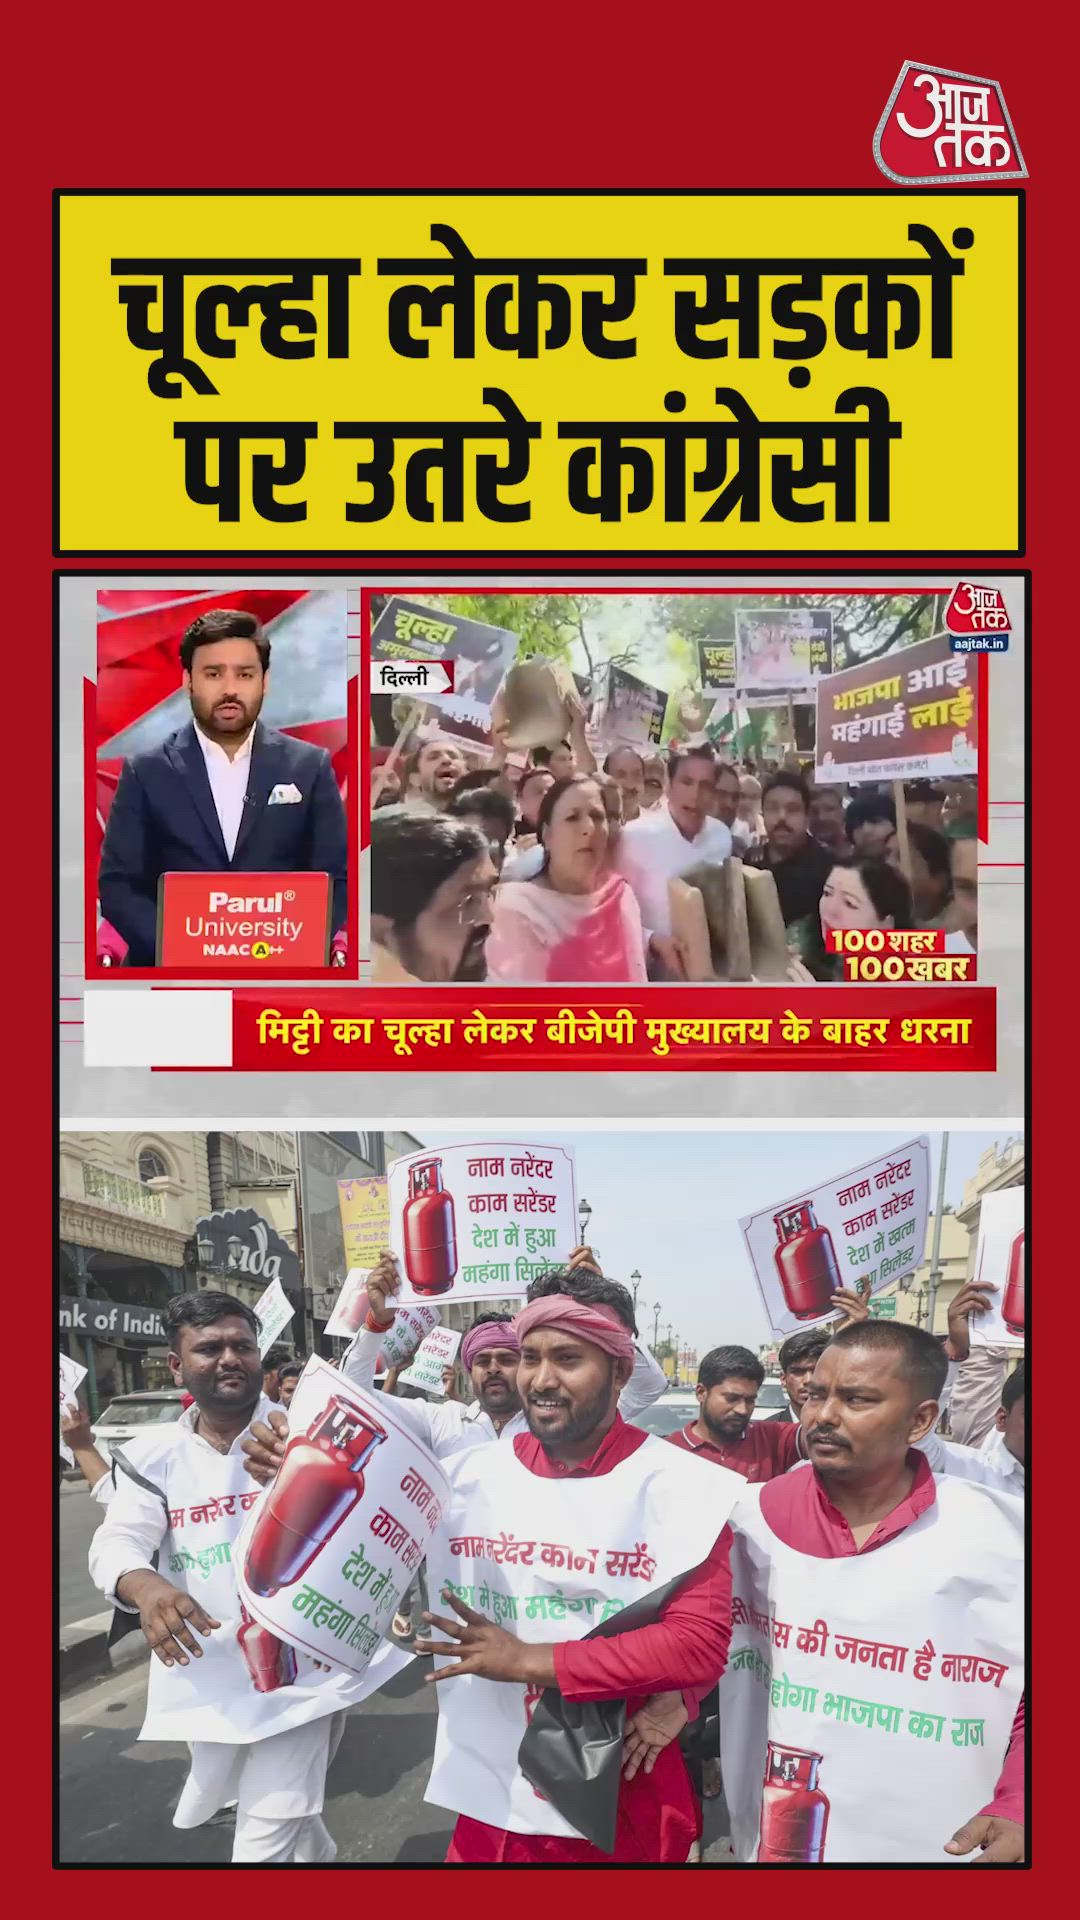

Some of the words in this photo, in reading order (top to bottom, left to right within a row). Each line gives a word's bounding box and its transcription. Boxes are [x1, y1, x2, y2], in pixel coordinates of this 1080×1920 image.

[833, 676, 901, 711] भाजपा
[907, 652, 969, 693] आई
[831, 702, 906, 744] महंगाई
[909, 686, 975, 729] लाई
[185, 917, 303, 941] University
[203, 944, 250, 956] NAAC
[467, 1158, 504, 1178] नाम
[510, 1151, 553, 1179] नरेंदर
[836, 1179, 871, 1207] नाम
[873, 1158, 912, 1190] नरेंदर
[468, 1194, 508, 1213] काम
[513, 1187, 556, 1213] सरेंडर
[842, 1208, 877, 1236] काम
[880, 1189, 915, 1220] सरेंडर
[472, 1223, 498, 1248] देश
[504, 1222, 521, 1247] में
[524, 1229, 556, 1254] हुआ
[847, 1245, 870, 1266] देश
[873, 1231, 885, 1254] में
[462, 1260, 510, 1283] महंगा
[94, 1308, 118, 1331] of
[400, 1467, 435, 1515] नाम
[369, 1506, 411, 1555] काम
[449, 1536, 485, 1558] नाम
[341, 1543, 377, 1590] देश
[292, 1583, 356, 1640] महंगा
[797, 1618, 830, 1657] की
[834, 1633, 909, 1673] जनता
[912, 1639, 936, 1682] है
[940, 1653, 1009, 1688] नाराज
[771, 1672, 819, 1713] होगा
[822, 1691, 904, 1734] भाजपा
[907, 1709, 946, 1742] का
[951, 1718, 985, 1747] राज
